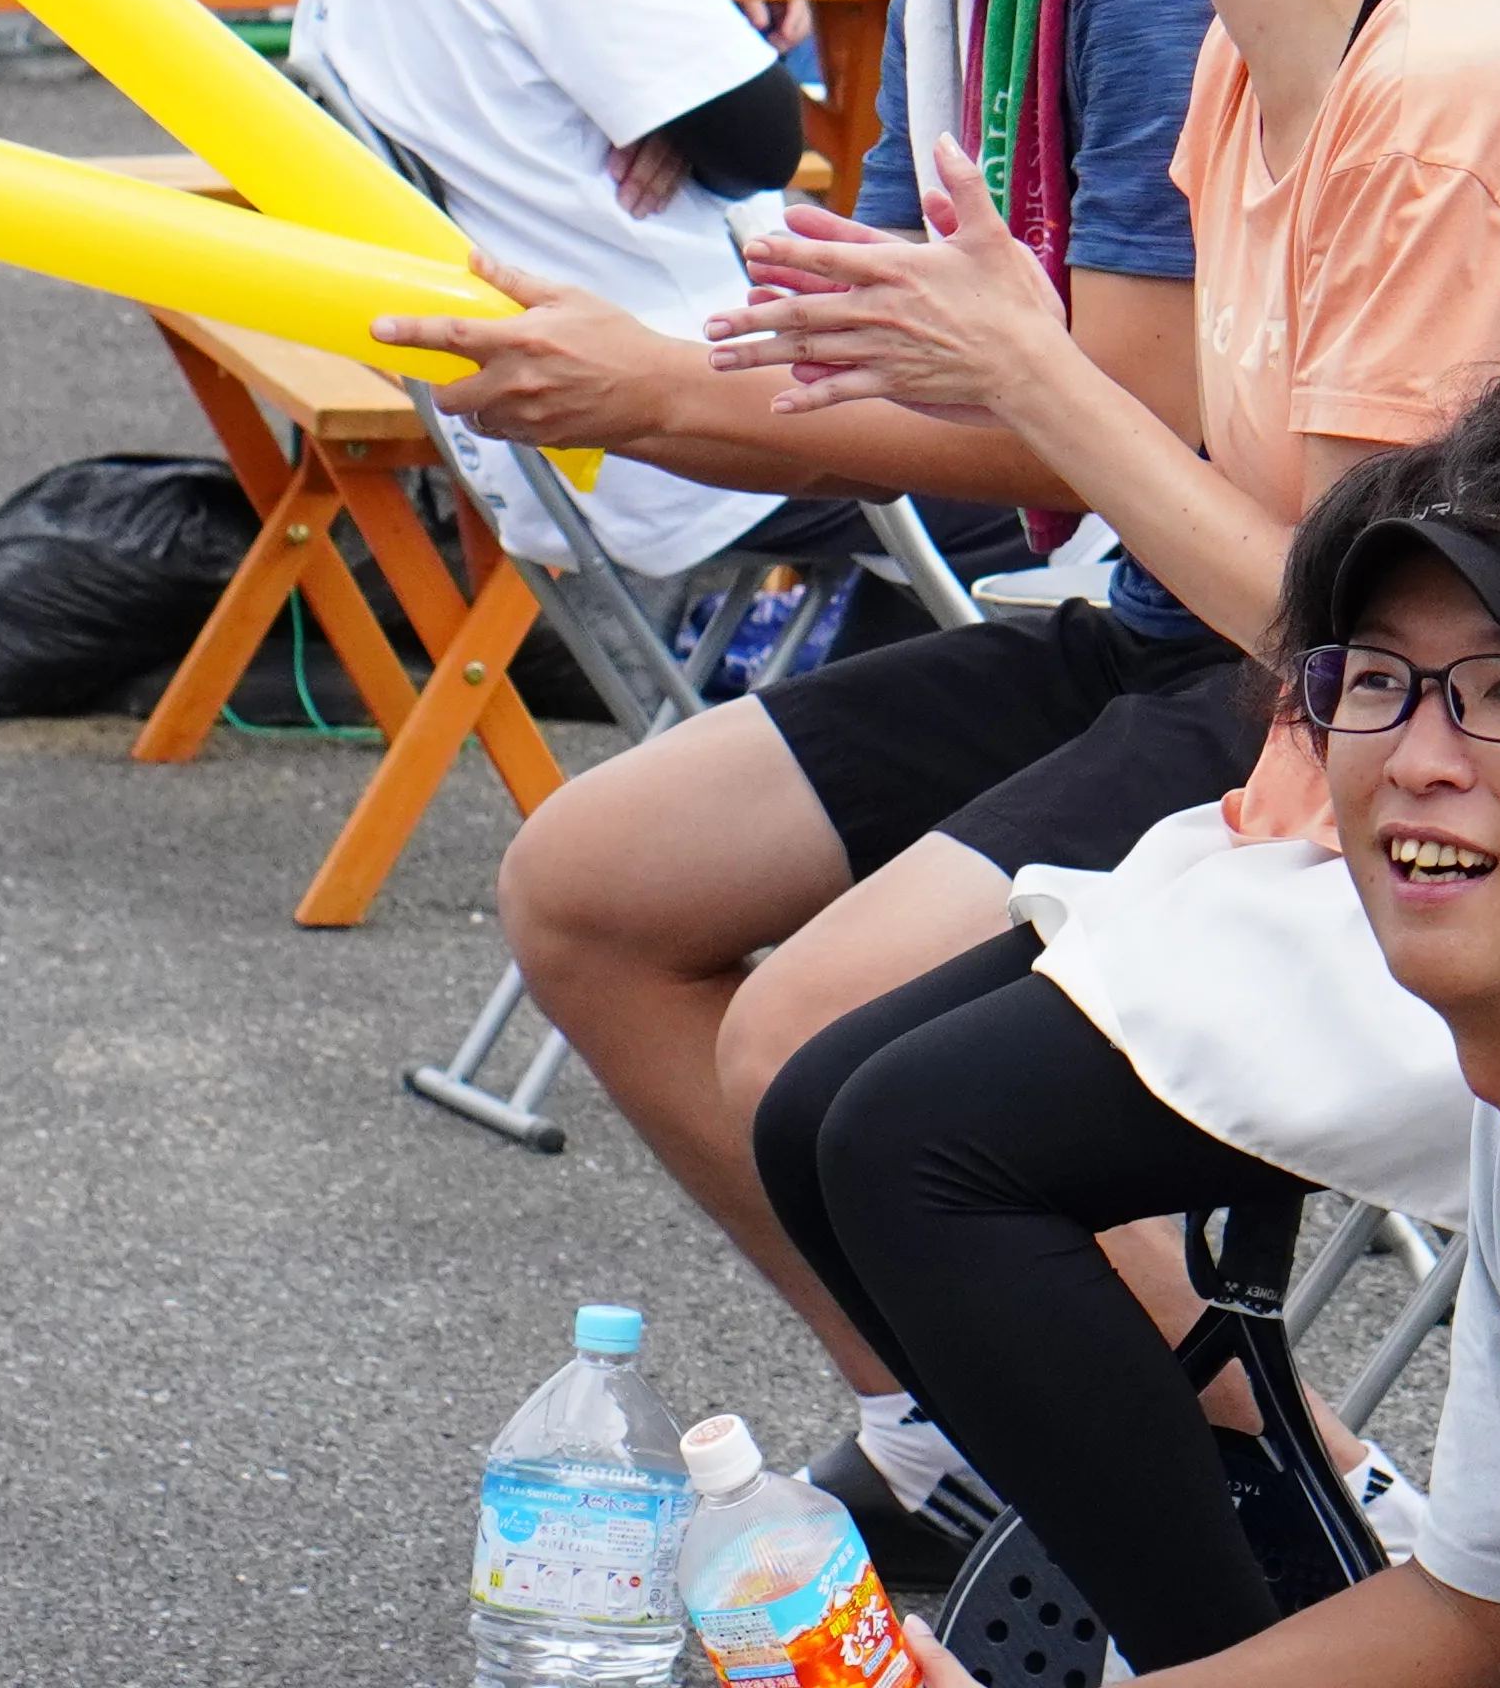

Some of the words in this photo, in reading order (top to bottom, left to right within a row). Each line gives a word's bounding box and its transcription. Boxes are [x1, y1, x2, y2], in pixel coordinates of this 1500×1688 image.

[526, 1488, 573, 1503] SUNTORY
[577, 1492, 621, 1512] 天然水
[840, 1594, 889, 1666] むぎ茶
